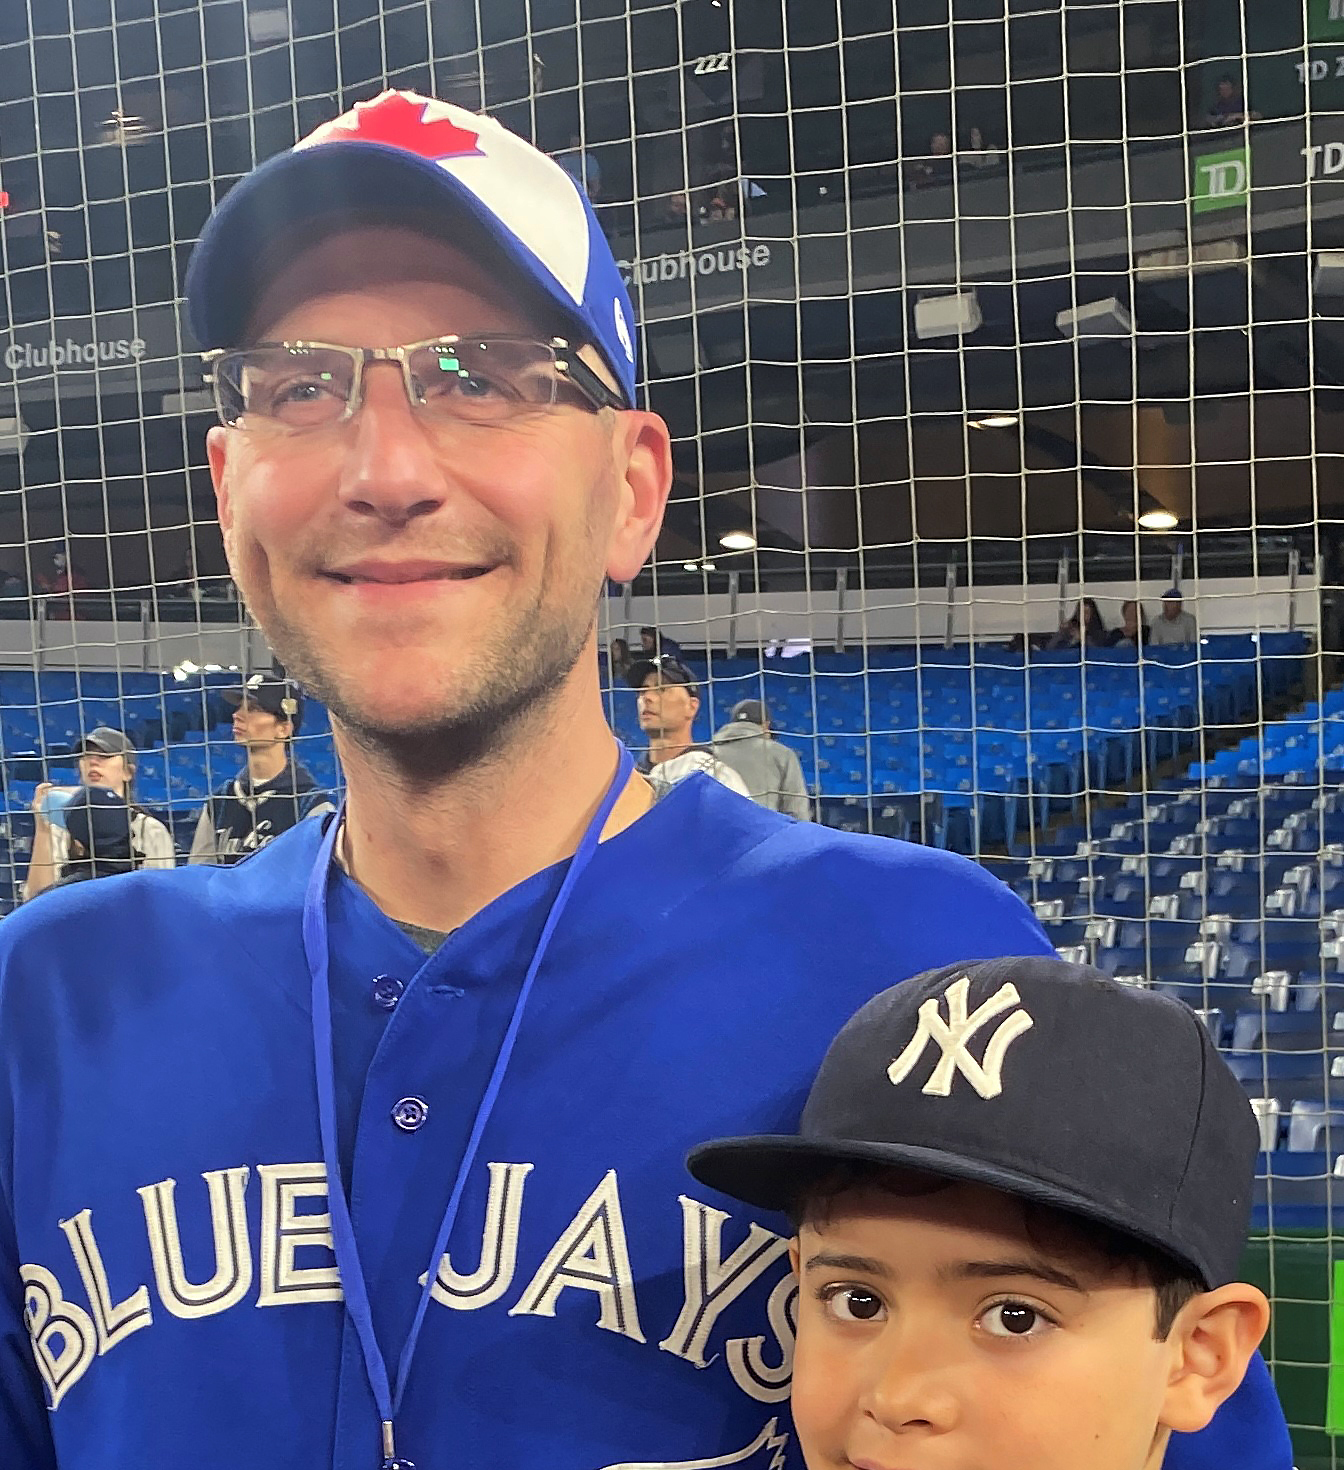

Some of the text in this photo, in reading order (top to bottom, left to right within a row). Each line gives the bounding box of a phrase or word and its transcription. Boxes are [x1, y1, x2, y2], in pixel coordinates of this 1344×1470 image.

[1295, 59, 1328, 83] TD
[1200, 160, 1246, 198] TD
[7, 338, 147, 370] Clubhouse
[887, 977, 1034, 1100] NY
[18, 1161, 800, 1412] BLUE JAYS
